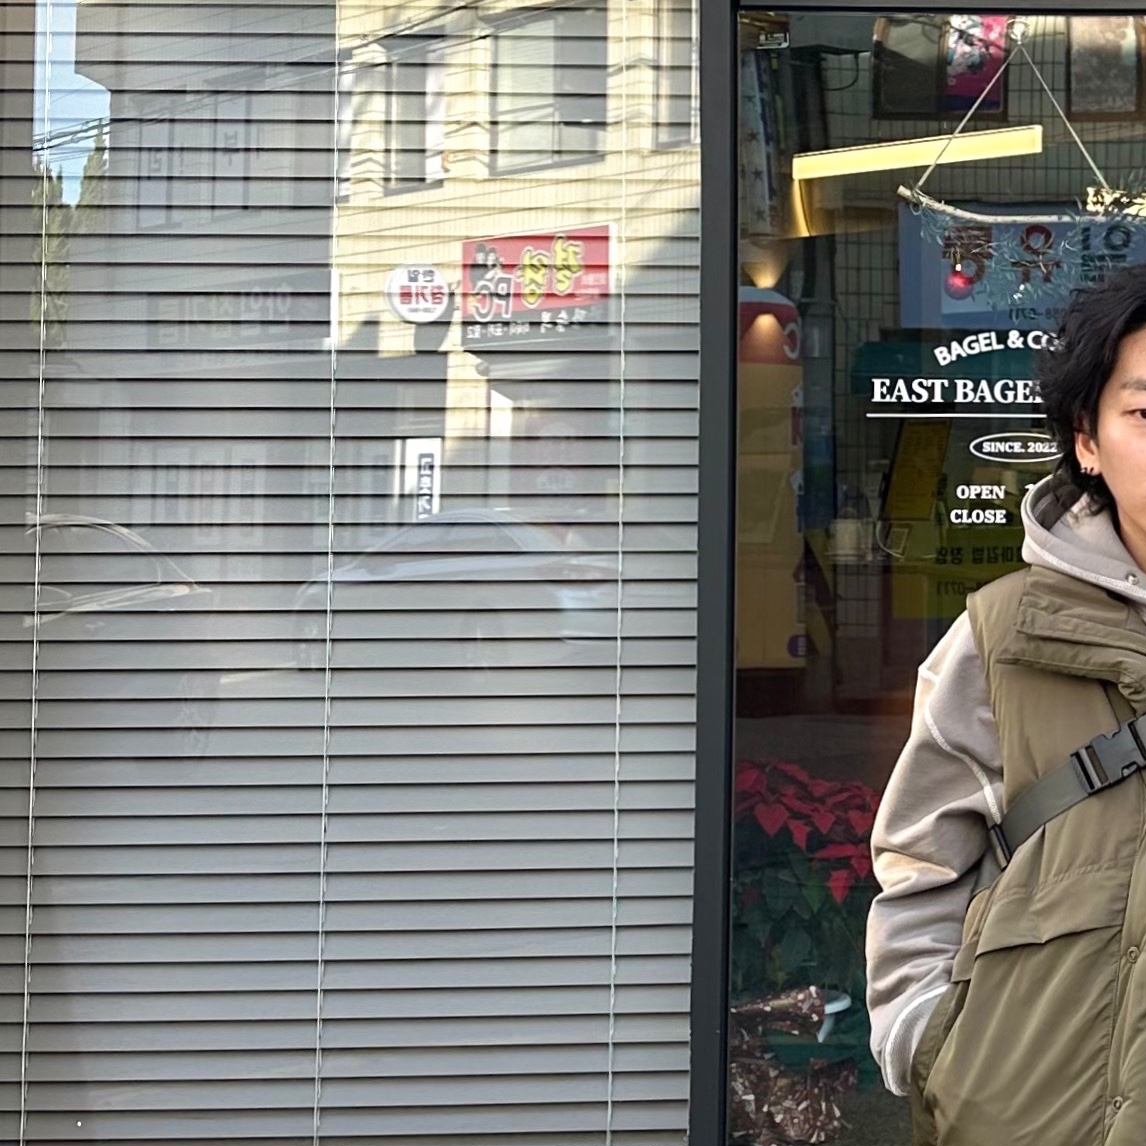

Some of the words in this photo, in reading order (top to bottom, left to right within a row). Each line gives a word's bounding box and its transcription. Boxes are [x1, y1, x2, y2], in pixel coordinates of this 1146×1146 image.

[933, 331, 1005, 366] BAGEL
[1006, 329, 1024, 349] &
[871, 378, 949, 404] EAST
[1027, 441, 1058, 453] 2022
[956, 484, 1006, 499] OPEN
[949, 509, 1007, 524] CLOSE
